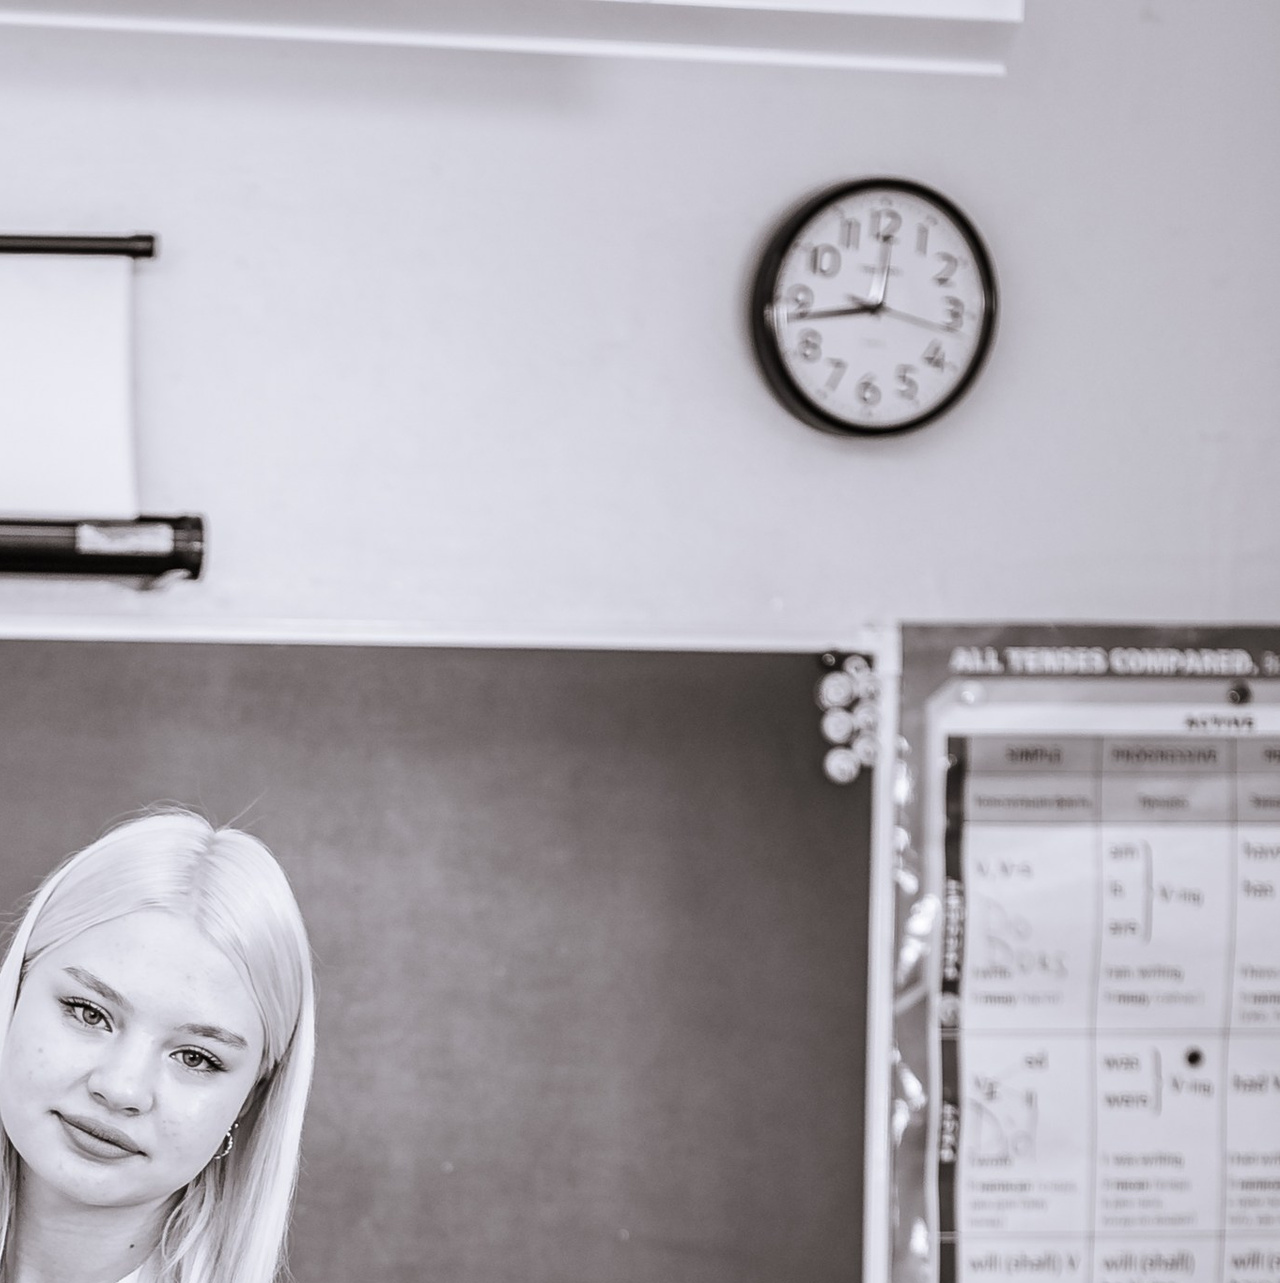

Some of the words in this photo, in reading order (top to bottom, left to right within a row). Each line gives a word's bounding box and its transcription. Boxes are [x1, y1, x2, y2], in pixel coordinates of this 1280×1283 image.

[870, 208, 903, 242] 12
[933, 252, 958, 287] 2
[797, 328, 823, 363] 8
[921, 338, 946, 372] 4
[825, 357, 849, 393] 7
[855, 372, 882, 406] 6
[894, 364, 920, 400] 5
